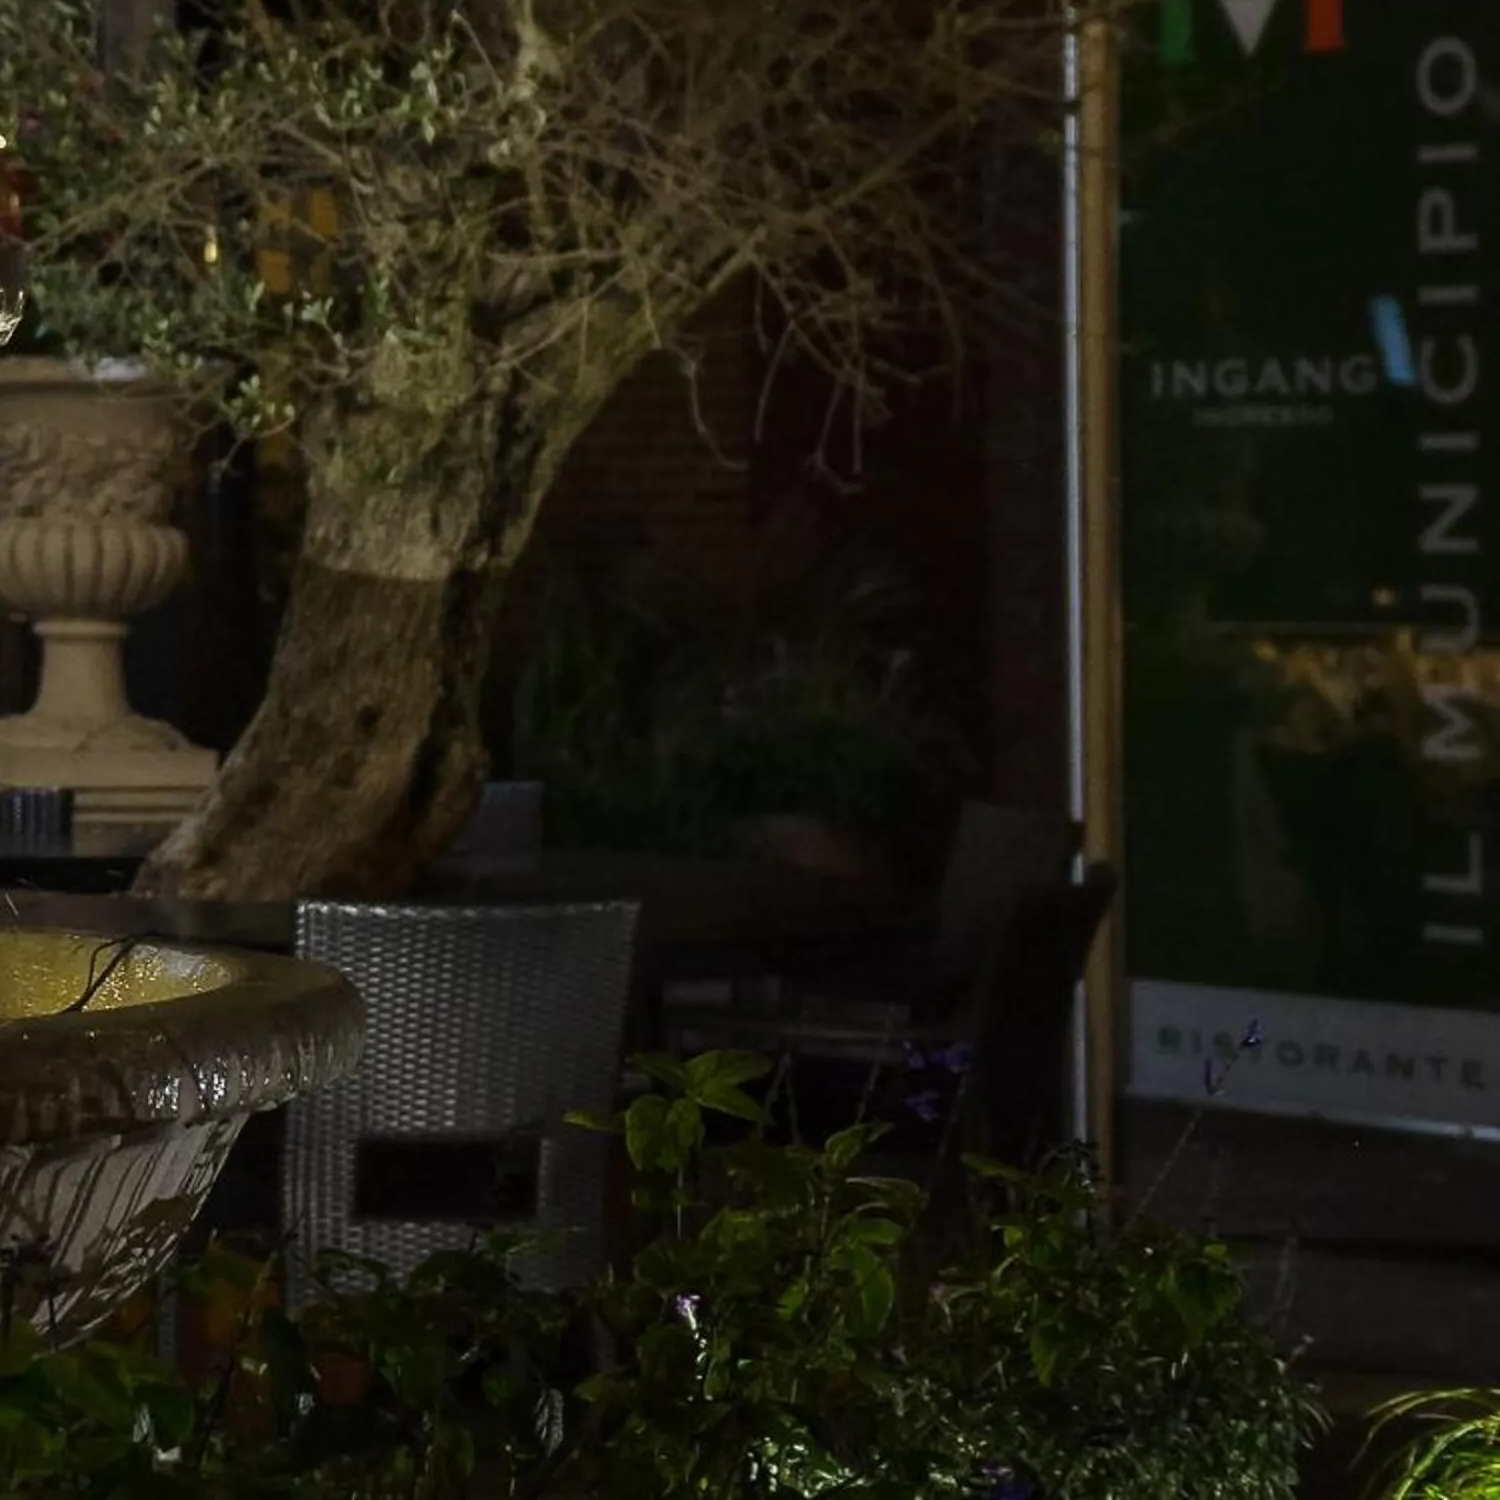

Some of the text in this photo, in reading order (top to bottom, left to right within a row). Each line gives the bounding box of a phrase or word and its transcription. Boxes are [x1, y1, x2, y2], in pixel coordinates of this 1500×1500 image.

[1150, 353, 1378, 399] INGANG
[1416, 35, 1484, 946] IL MUNICIPIO
